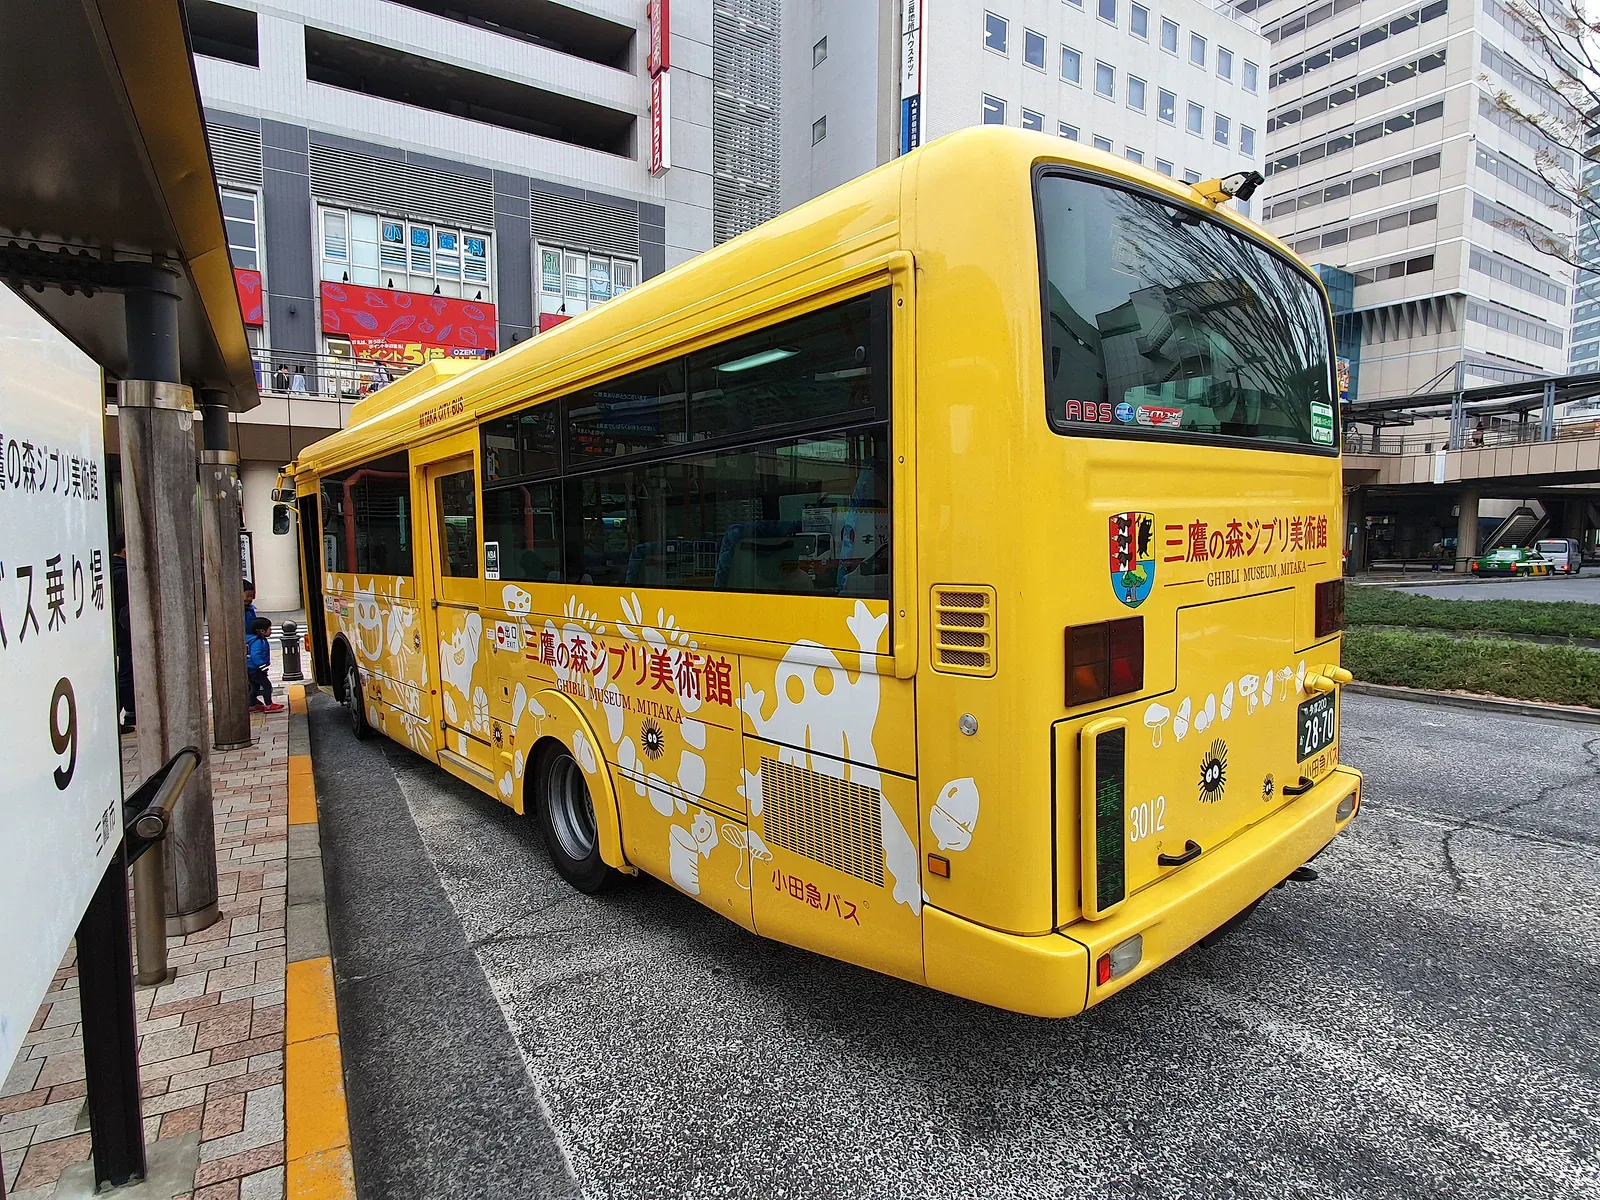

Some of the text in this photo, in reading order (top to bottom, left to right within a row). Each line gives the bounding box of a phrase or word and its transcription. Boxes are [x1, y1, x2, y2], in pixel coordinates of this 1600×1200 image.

[453, 348, 477, 356] OZEKI
[451, 396, 464, 416] BUS
[1065, 399, 1113, 422] ABS
[1163, 514, 1328, 564] 三鷹の森ジブリ美術館
[1207, 569, 1240, 588] GHIBLI
[505, 625, 517, 639] 出口
[506, 640, 516, 649] EXIT
[525, 629, 733, 708] 三鷹の森ジブリ美術館
[556, 677, 587, 698] GHIBLI
[49, 676, 78, 791] 9
[1304, 747, 1338, 779] 小田急バス
[1130, 795, 1166, 843] 3012
[771, 868, 861, 926] 小田急バス
